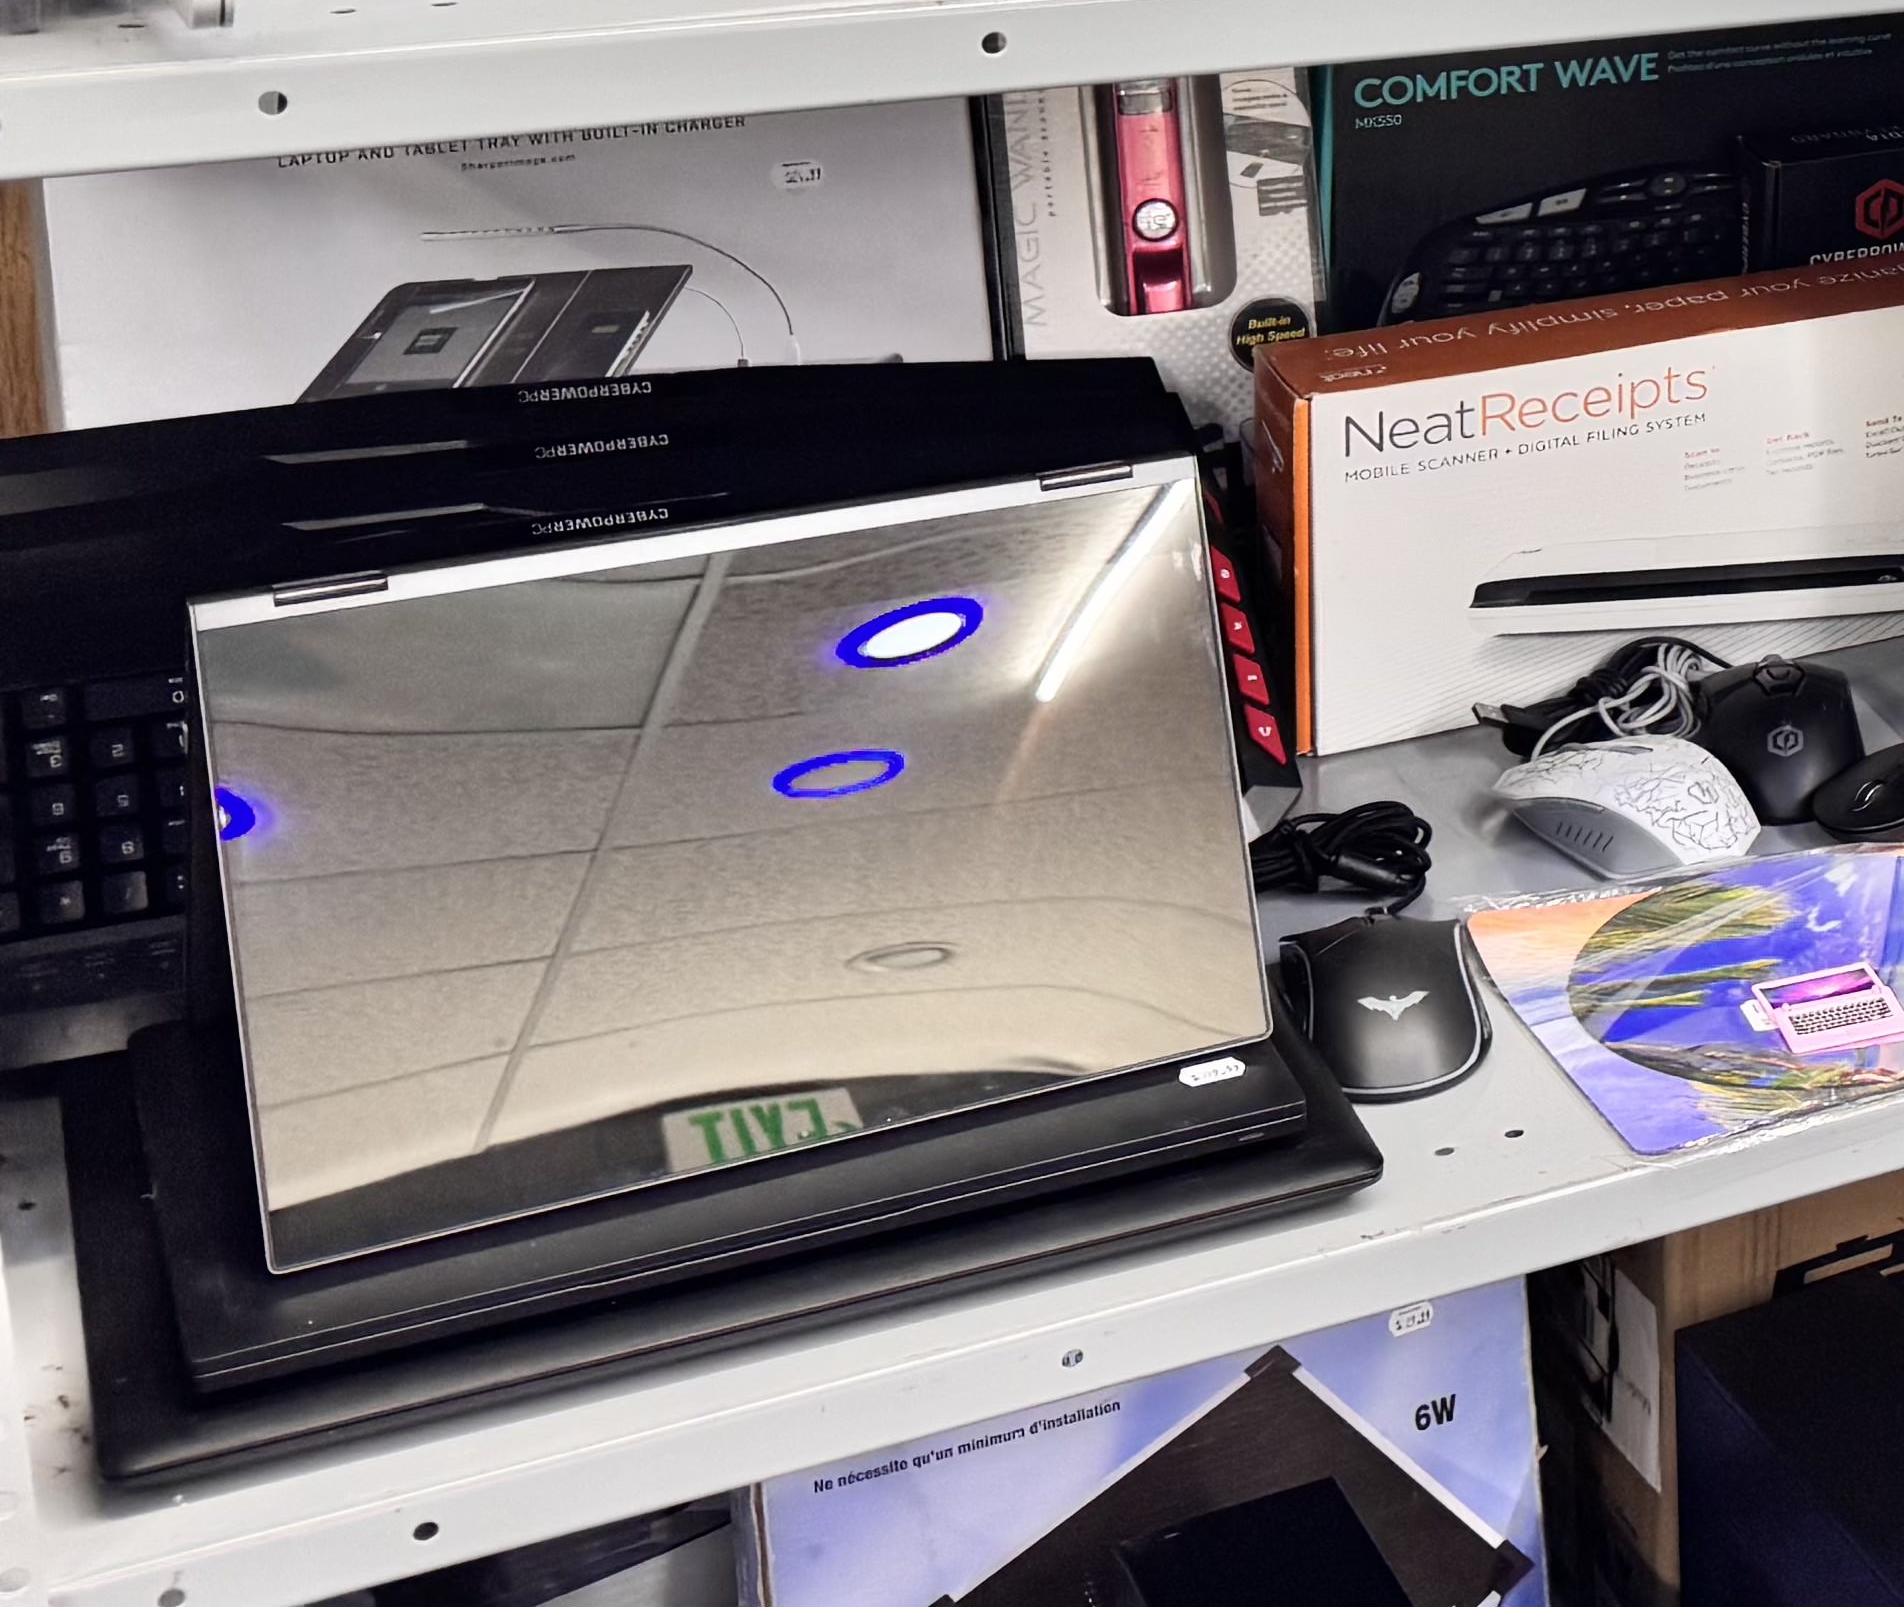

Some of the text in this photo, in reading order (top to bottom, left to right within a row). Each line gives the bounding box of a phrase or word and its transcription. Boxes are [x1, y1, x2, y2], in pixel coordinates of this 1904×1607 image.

[1354, 53, 1659, 108] COMFORT WAVE
[278, 115, 746, 169] LAPTOP AND TABLET TRAY WITH BUILT-IN CHARGER
[1015, 201, 1047, 327] MAGIC
[1741, 277, 1811, 298] your
[1236, 326, 1306, 346] High Speed
[1248, 315, 1291, 331] Built-in
[1398, 325, 1478, 350] your
[1489, 305, 1619, 339] simplify
[519, 380, 652, 404] CYBERPOWERPC
[1344, 366, 1709, 459] NeatReceipts
[535, 433, 669, 460] CYBERPOWERPC
[1344, 414, 1707, 484] MOBILE SCANNER DIGITAL FILING SYSTEM
[532, 505, 669, 536] CYBERPOWERPC
[1414, 1394, 1458, 1432] 6W
[813, 1477, 833, 1493] Ne
[957, 1427, 1026, 1457] minimum
[1029, 1400, 1121, 1436] d'installation
